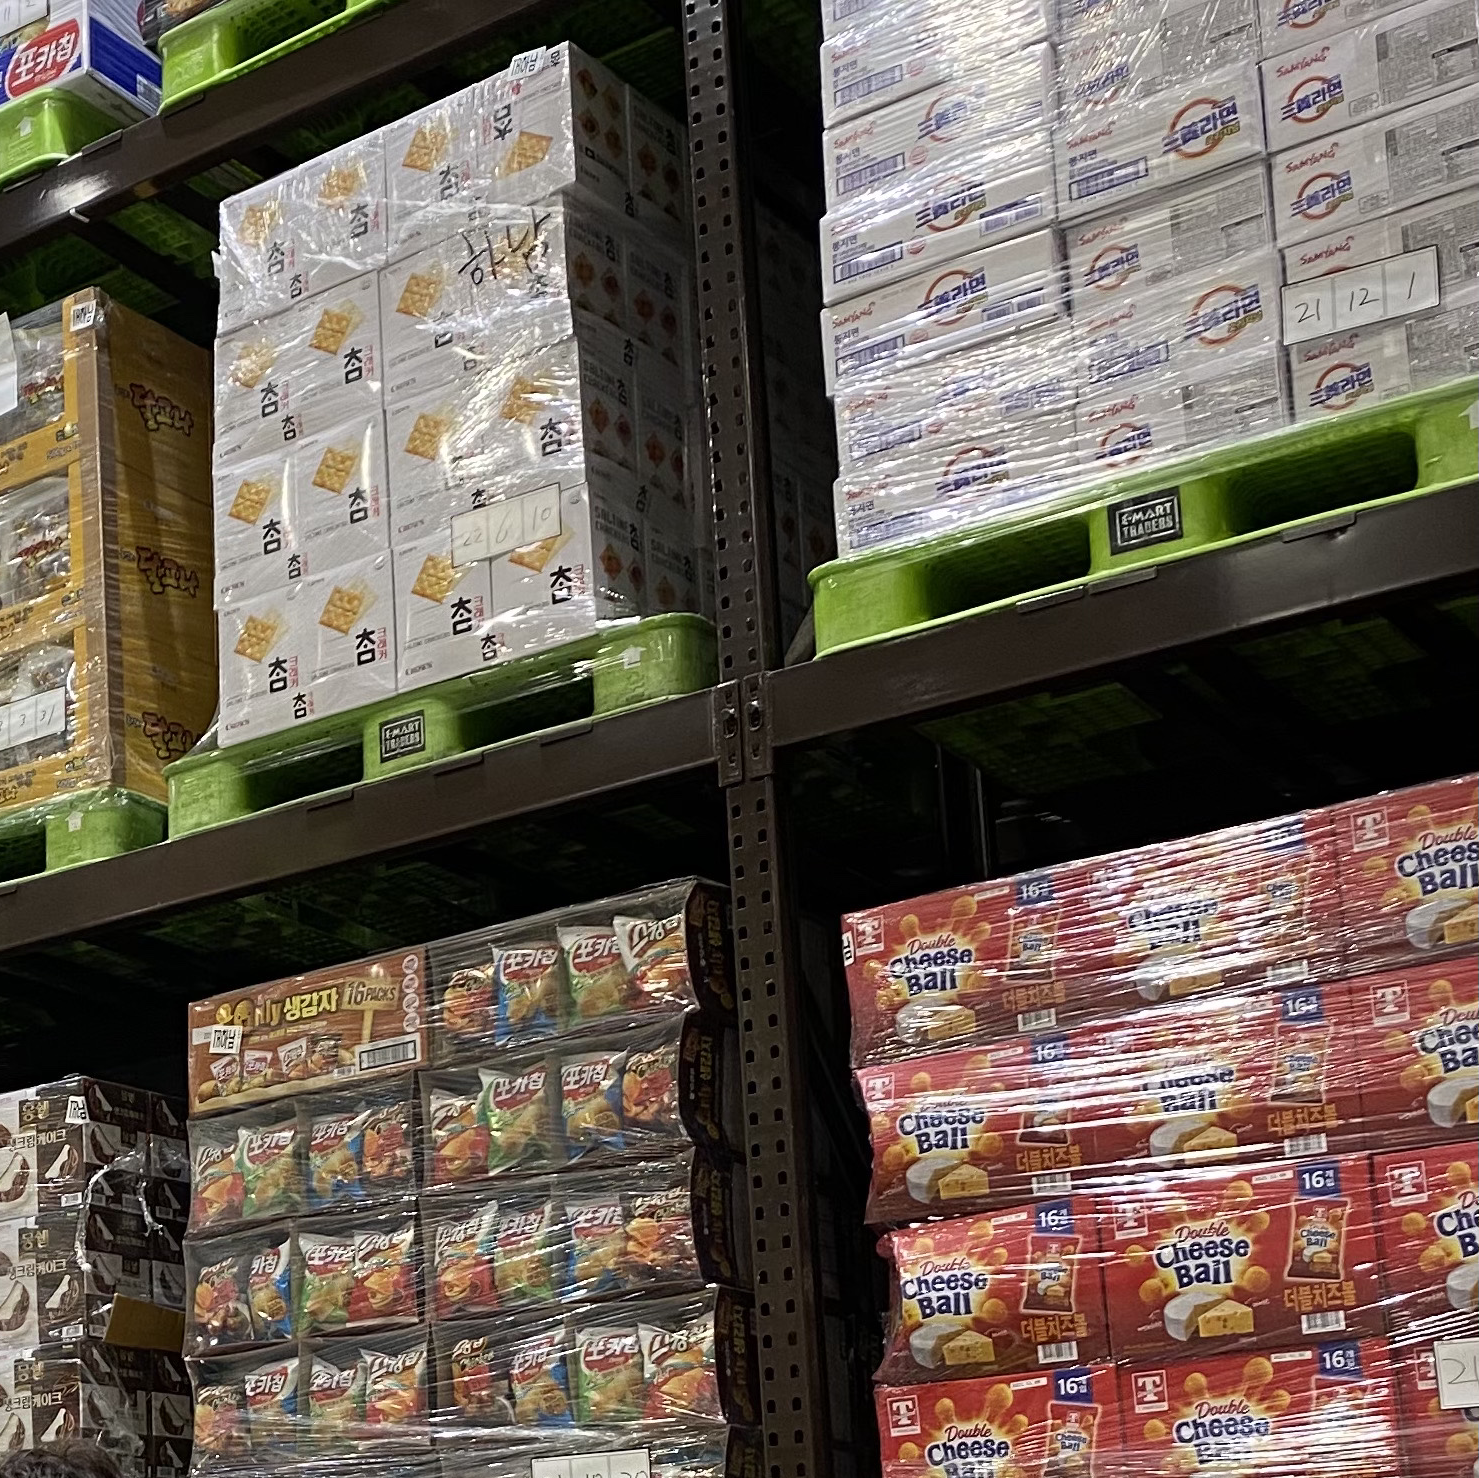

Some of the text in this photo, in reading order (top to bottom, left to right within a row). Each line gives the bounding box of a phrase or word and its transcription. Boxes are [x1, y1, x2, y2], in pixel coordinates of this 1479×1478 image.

[16, 30, 77, 87] 포카칩
[1295, 300, 1321, 323] 21
[1348, 288, 1379, 309] 12
[349, 487, 368, 524] 참
[1121, 503, 1174, 527] E-MART
[263, 518, 281, 555] 참
[450, 596, 473, 636] 참
[355, 628, 376, 665] 참
[268, 657, 288, 693] 참
[293, 692, 307, 719] 참
[1419, 828, 1478, 848] Double
[508, 943, 558, 971] 포카칩
[907, 932, 958, 952] Double
[890, 945, 974, 980] Cheese
[906, 964, 959, 997] Ball
[284, 988, 339, 1021] 생감자
[898, 1105, 984, 1136] Cheese
[917, 1123, 971, 1155] Ball
[1301, 1169, 1324, 1190] 16
[1175, 1221, 1230, 1242] Double
[1155, 1238, 1250, 1270] Cheese
[902, 1272, 989, 1301] Cheese
[1175, 1257, 1234, 1288] Ball
[917, 1291, 972, 1319] Ball
[1284, 1281, 1357, 1309] 더블치즈볼
[1021, 1315, 1088, 1342] 더블치즈볼
[1057, 1376, 1075, 1396] 16
[1195, 1399, 1251, 1420] Double
[944, 1423, 993, 1442] Double
[1173, 1413, 1270, 1443] Cheese
[926, 1437, 1010, 1470] Cheese
